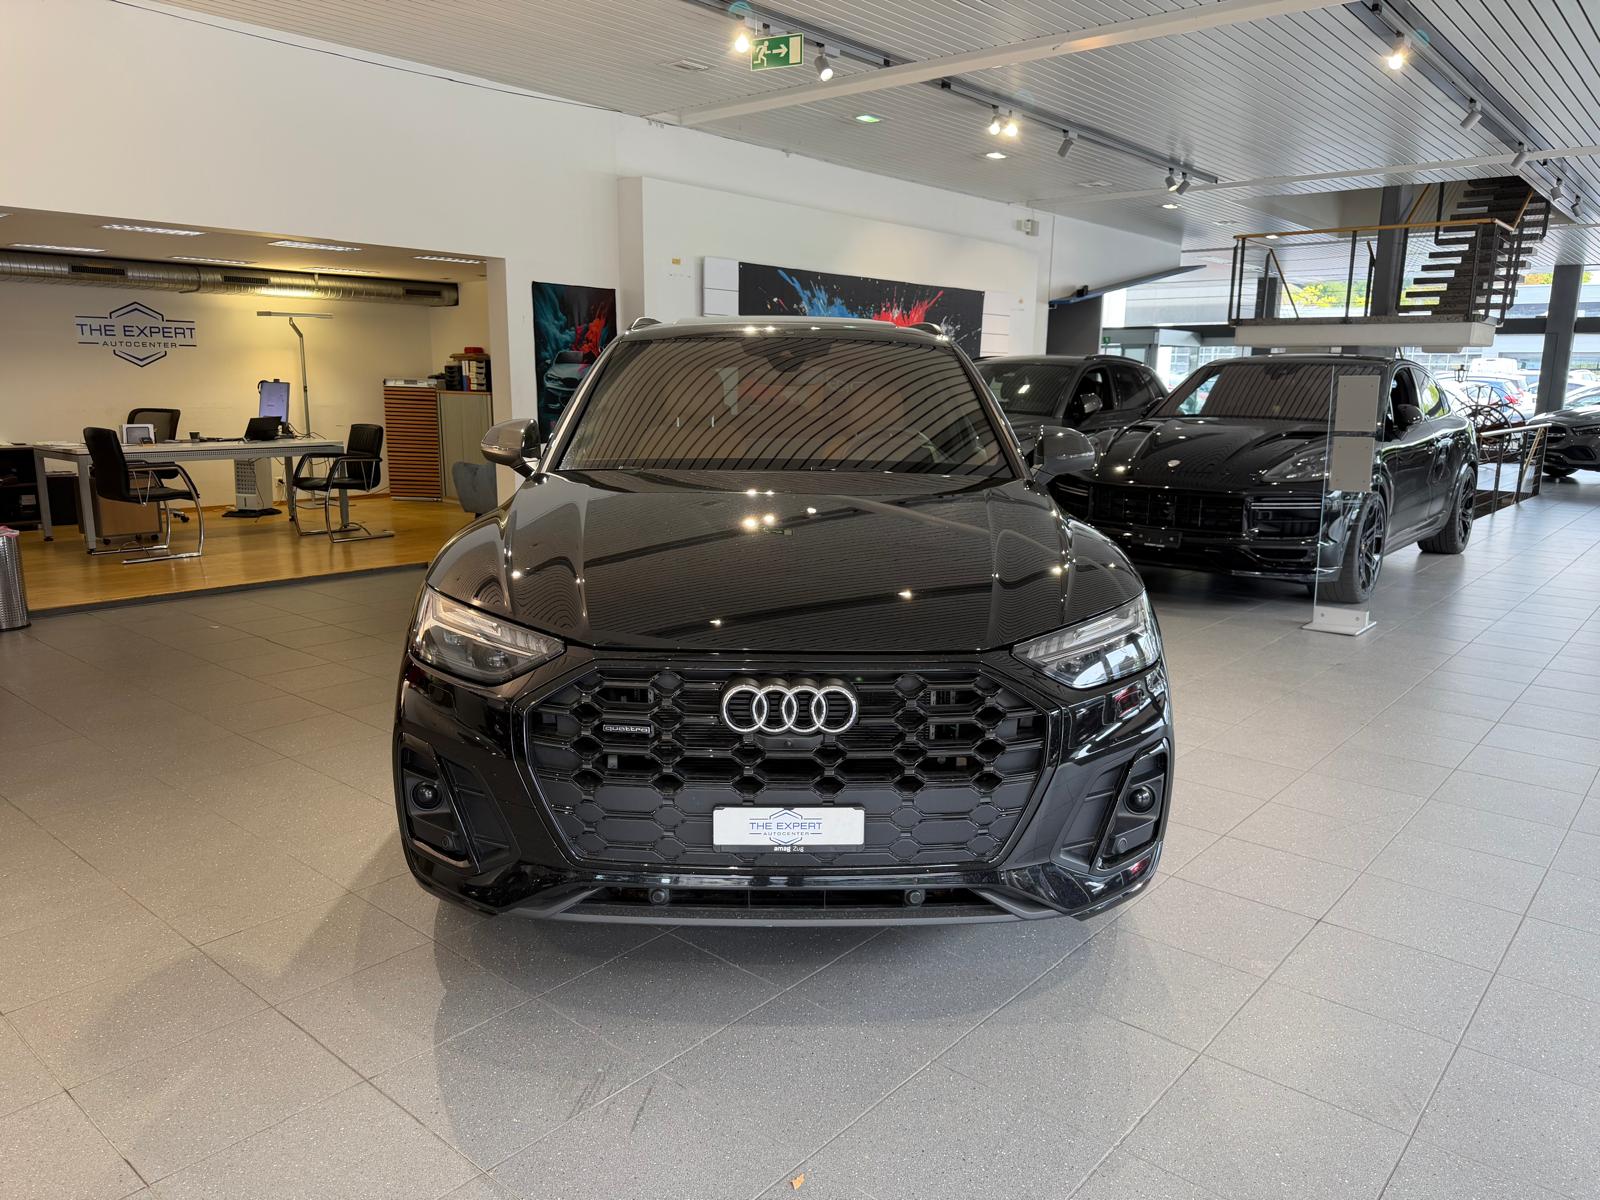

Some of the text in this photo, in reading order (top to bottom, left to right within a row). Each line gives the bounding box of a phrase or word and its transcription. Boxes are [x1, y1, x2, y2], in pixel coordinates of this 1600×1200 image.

[76, 323, 195, 339] THE EXPERT
[750, 822, 822, 830] THE EXPERT
